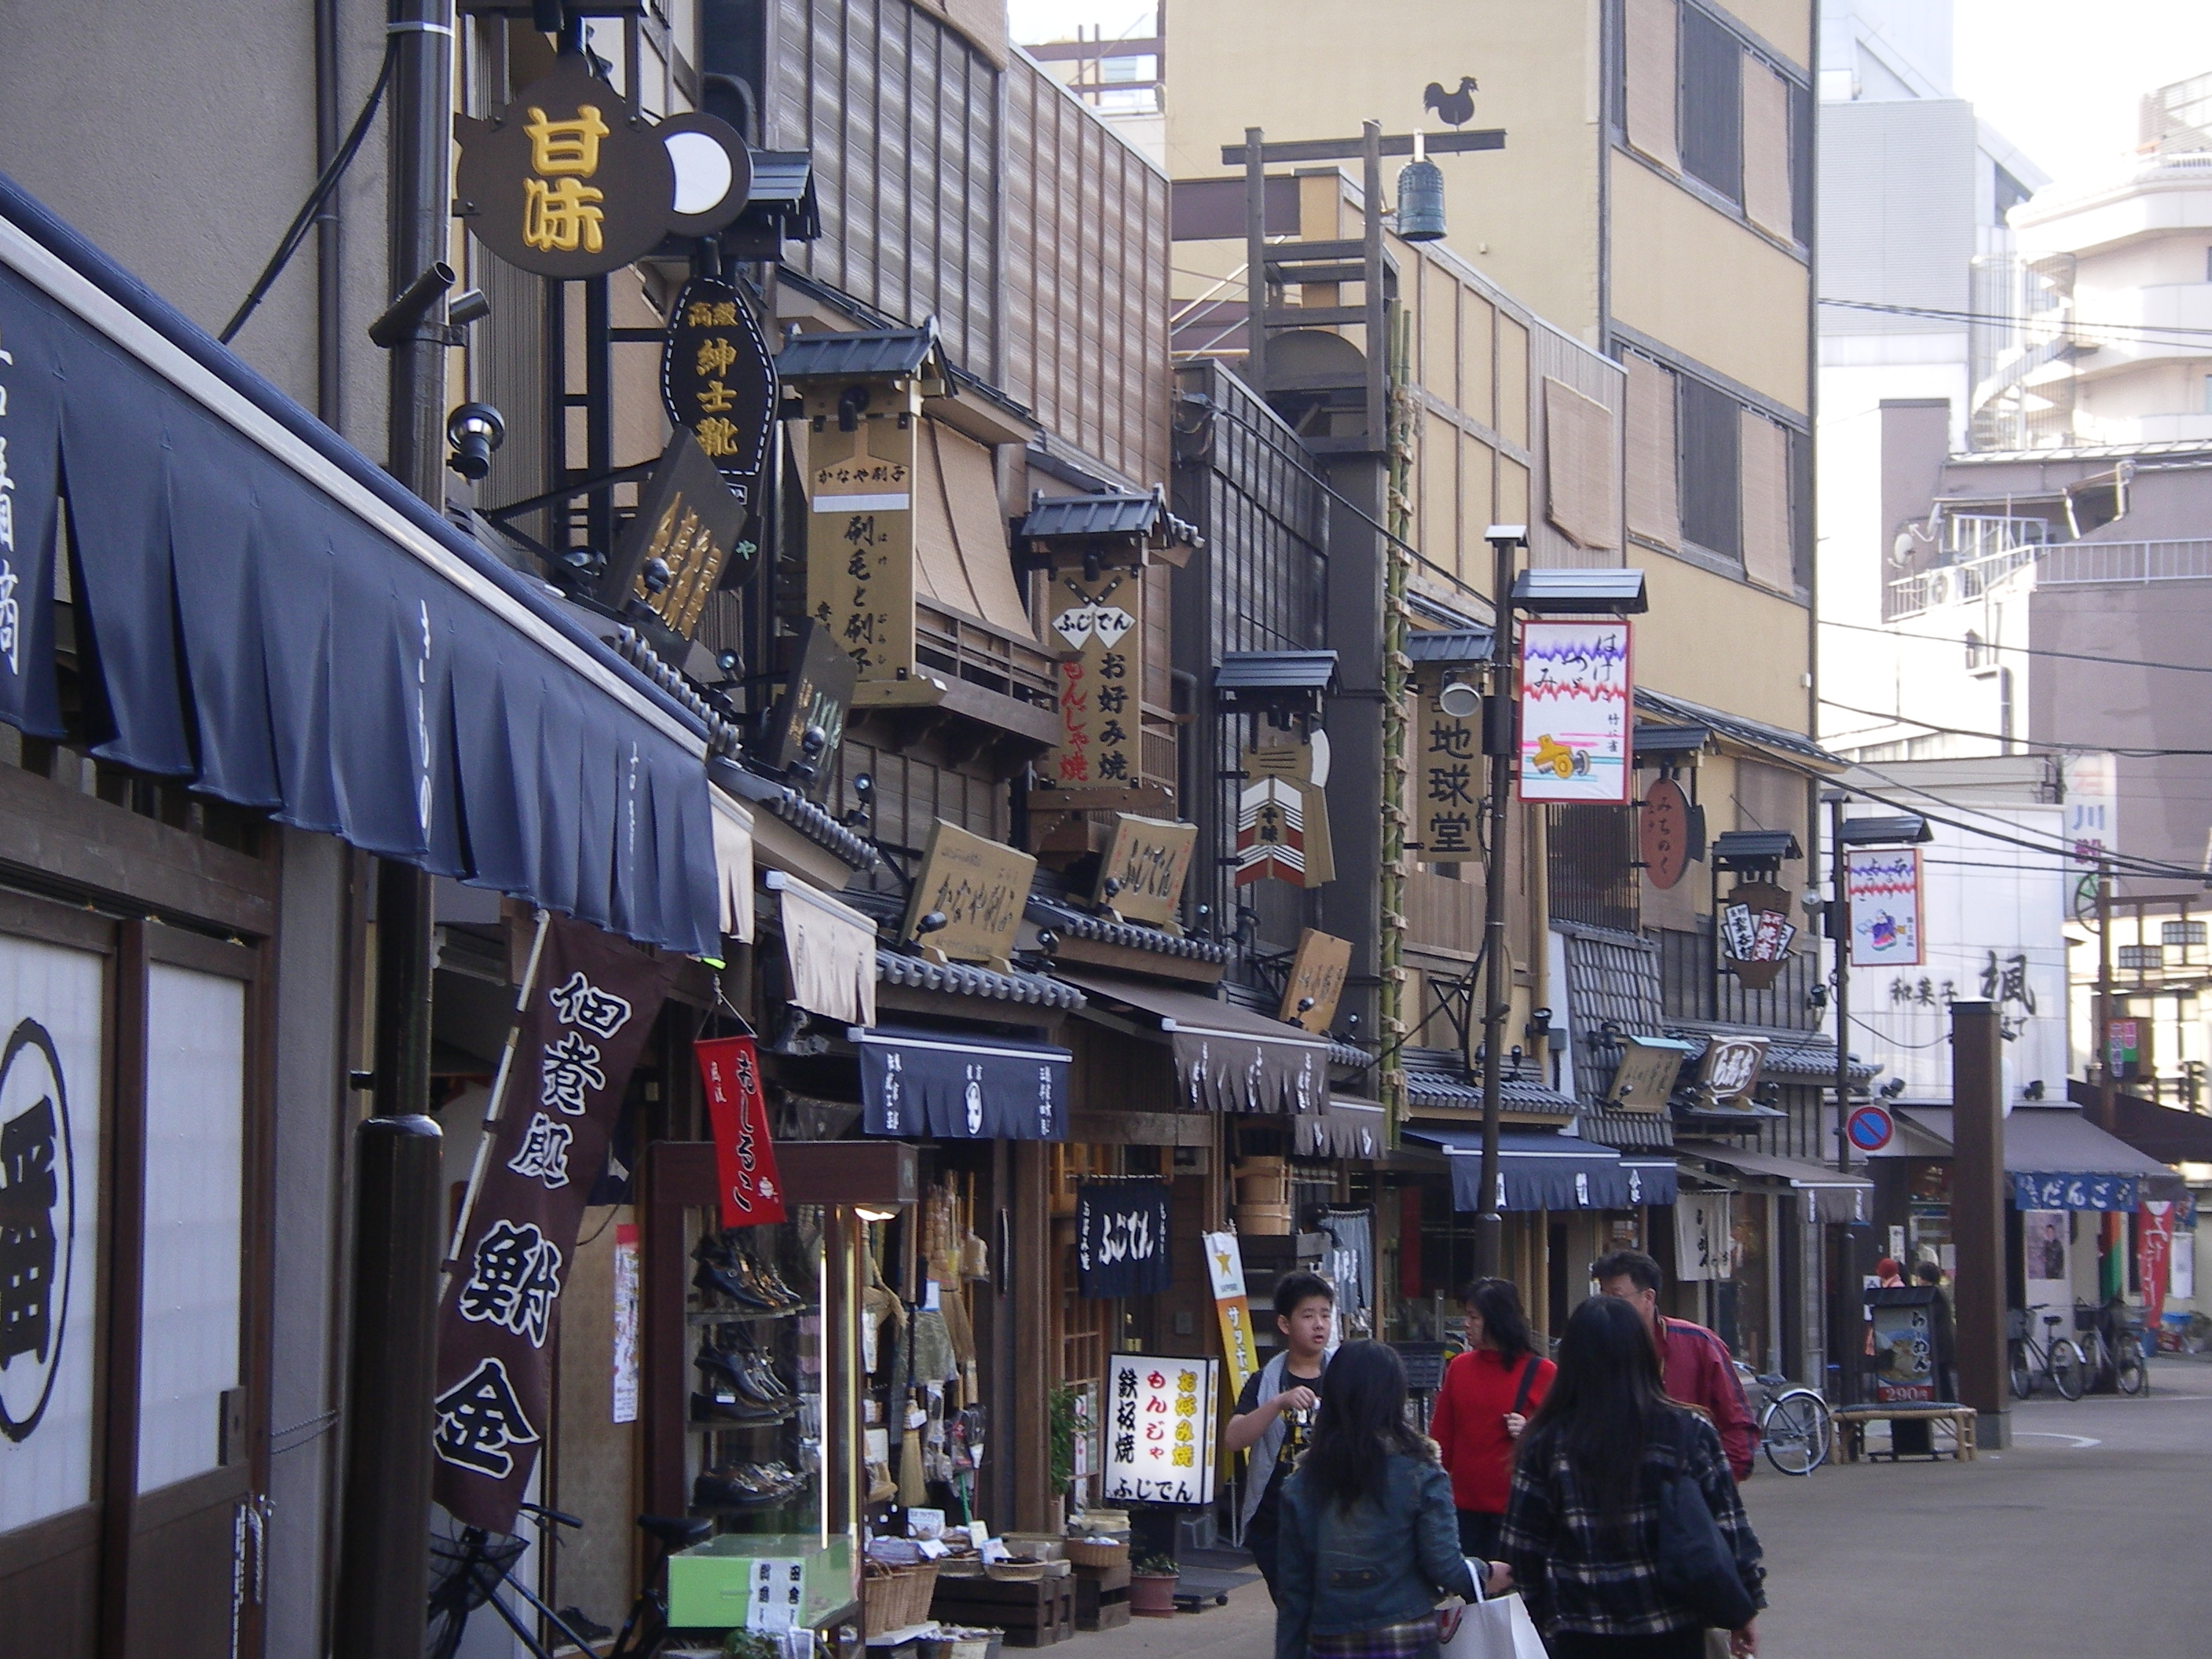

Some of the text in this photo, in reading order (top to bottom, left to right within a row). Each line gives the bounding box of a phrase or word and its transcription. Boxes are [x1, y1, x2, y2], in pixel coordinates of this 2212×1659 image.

[523, 104, 610, 254] 甘味
[688, 301, 738, 328] 高級
[696, 337, 738, 457] 紳士靴
[819, 465, 906, 485] かなや刷子
[844, 515, 874, 674] 刷毛と刷子
[1060, 661, 1090, 782] もんじゃ焼
[1097, 652, 1129, 781] お好み焼
[1428, 720, 1474, 852] 地球堂
[1657, 797, 1672, 873] みちのく
[1889, 976, 1959, 1006] 和菓子
[1098, 1210, 1155, 1265] ふじでん
[2042, 1179, 2111, 1210] だんご
[1114, 1367, 1138, 1464] 鉄板焼
[1145, 1370, 1167, 1459] もんじゃ
[1172, 1368, 1199, 1468] お好み焼
[1113, 1477, 1194, 1502] ふじでん
